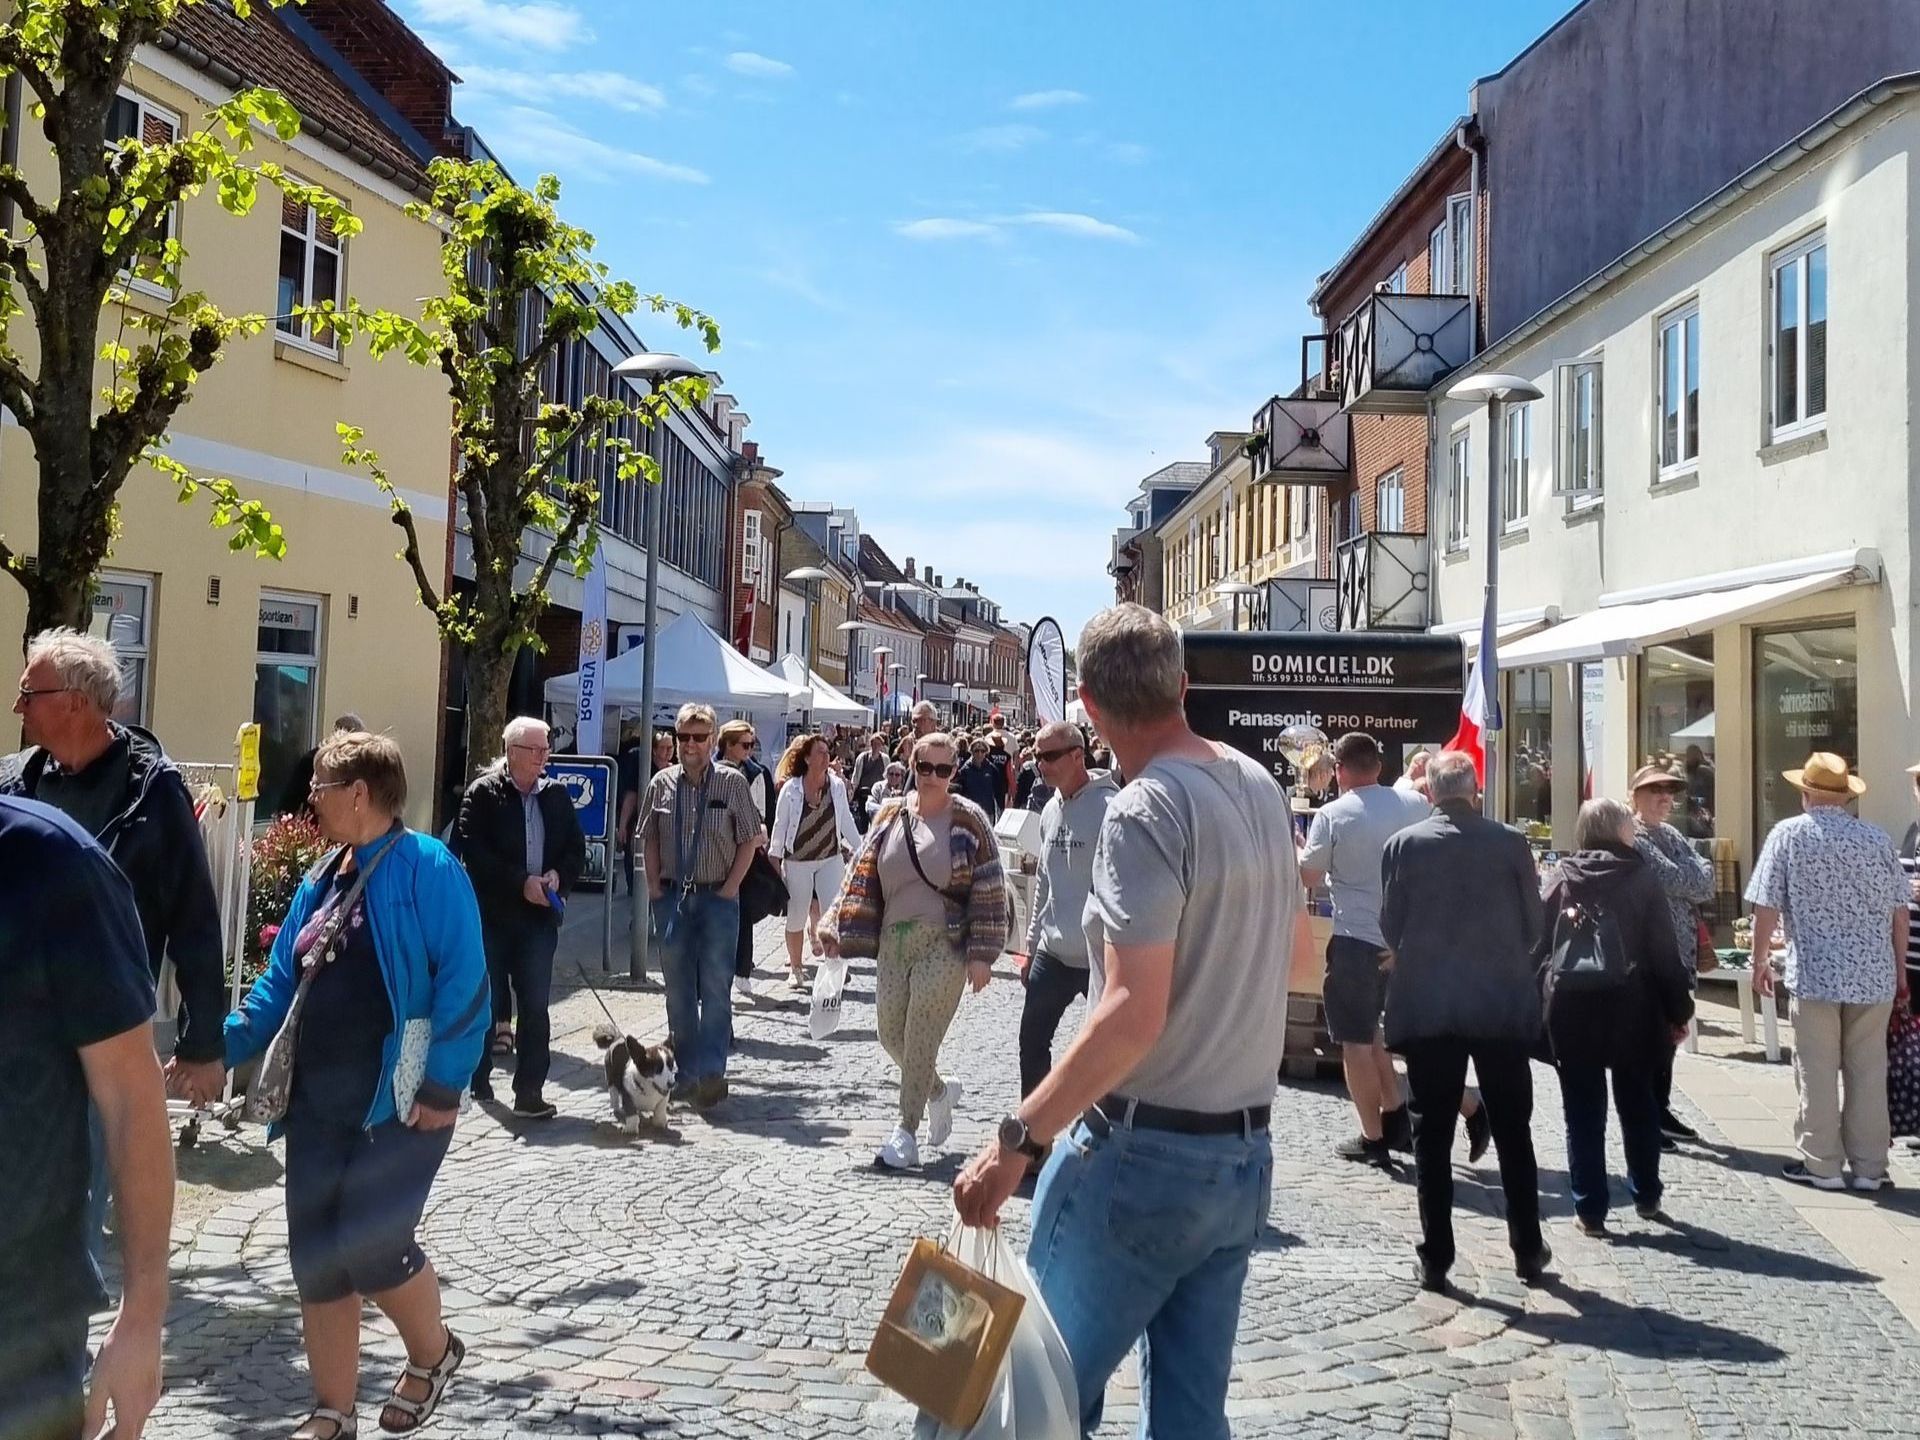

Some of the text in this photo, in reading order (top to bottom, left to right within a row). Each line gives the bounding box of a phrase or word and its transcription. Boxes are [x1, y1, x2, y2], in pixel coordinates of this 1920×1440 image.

[1252, 654, 1395, 675] DOMICIEL.DK
[1252, 673, 1265, 682] Tlf:
[1267, 673, 1278, 682] 55
[1280, 674, 1291, 682] 99
[1293, 674, 1304, 682] 33
[1306, 674, 1317, 682] 00
[1324, 675, 1342, 684] Aut.
[1228, 710, 1418, 729] Panasonic PRO Partner
